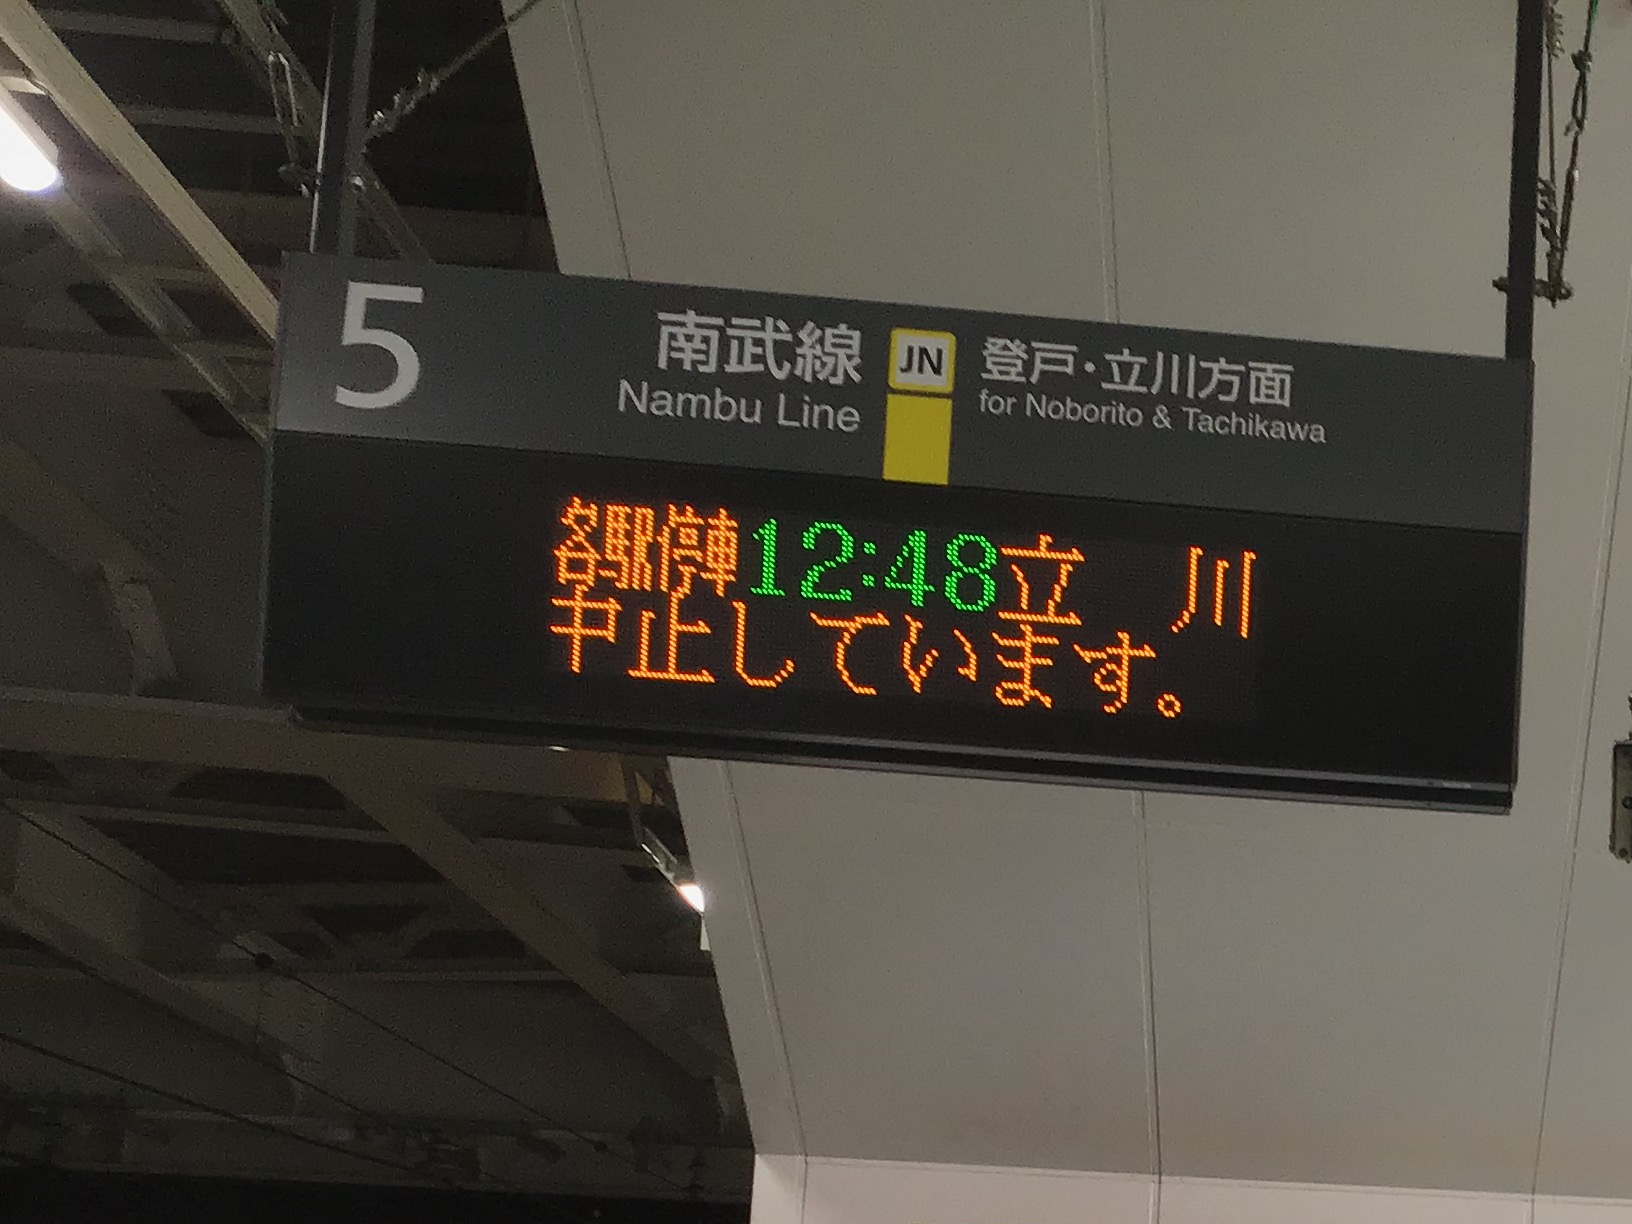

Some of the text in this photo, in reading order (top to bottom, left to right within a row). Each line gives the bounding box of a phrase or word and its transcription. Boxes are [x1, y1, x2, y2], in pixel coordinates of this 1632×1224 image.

[335, 281, 425, 409] 5
[656, 309, 863, 385] 南武線
[900, 344, 944, 377] JN
[980, 336, 1296, 408] 登戸・立川方面
[617, 378, 862, 433] Nambu Line
[978, 387, 1328, 444] for Noborito & Tachikawa
[750, 518, 998, 613] 12:48
